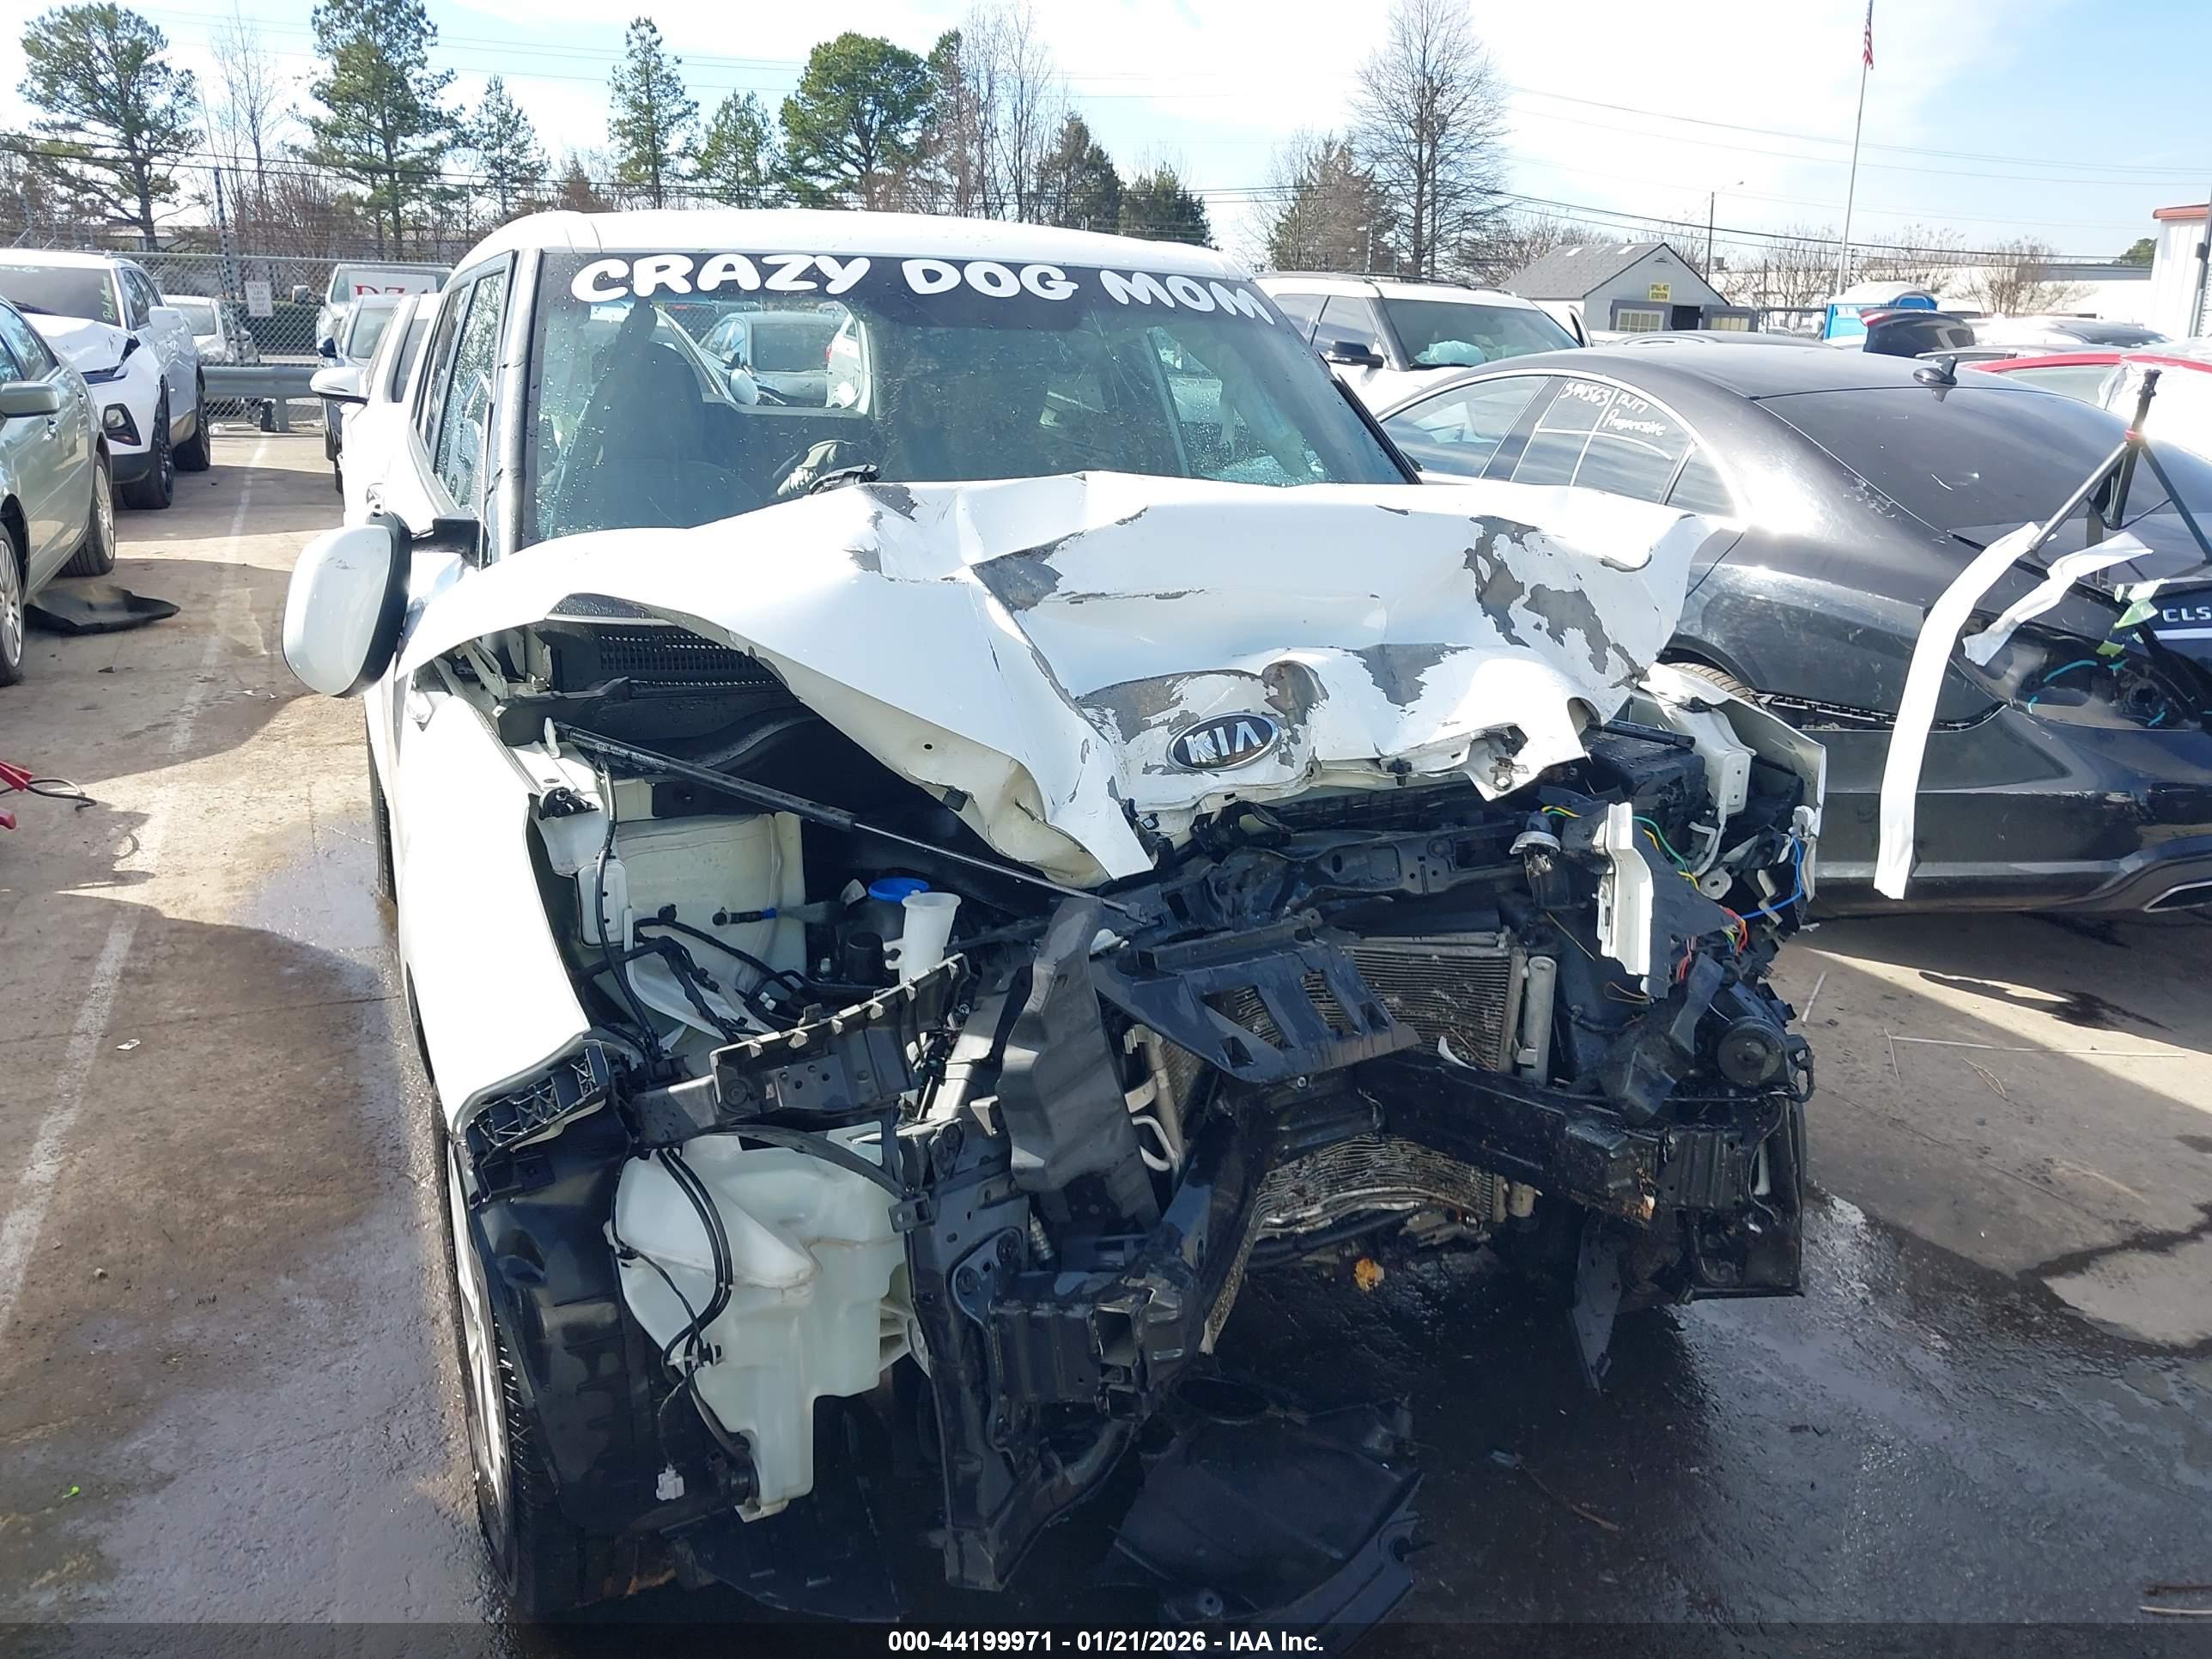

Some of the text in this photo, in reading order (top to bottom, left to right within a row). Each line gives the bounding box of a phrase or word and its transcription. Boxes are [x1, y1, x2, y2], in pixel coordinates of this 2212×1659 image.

[571, 253, 1275, 325] CRAZY DOG MOM
[2162, 606, 2212, 623] CLS
[1183, 720, 1264, 764] KIA
